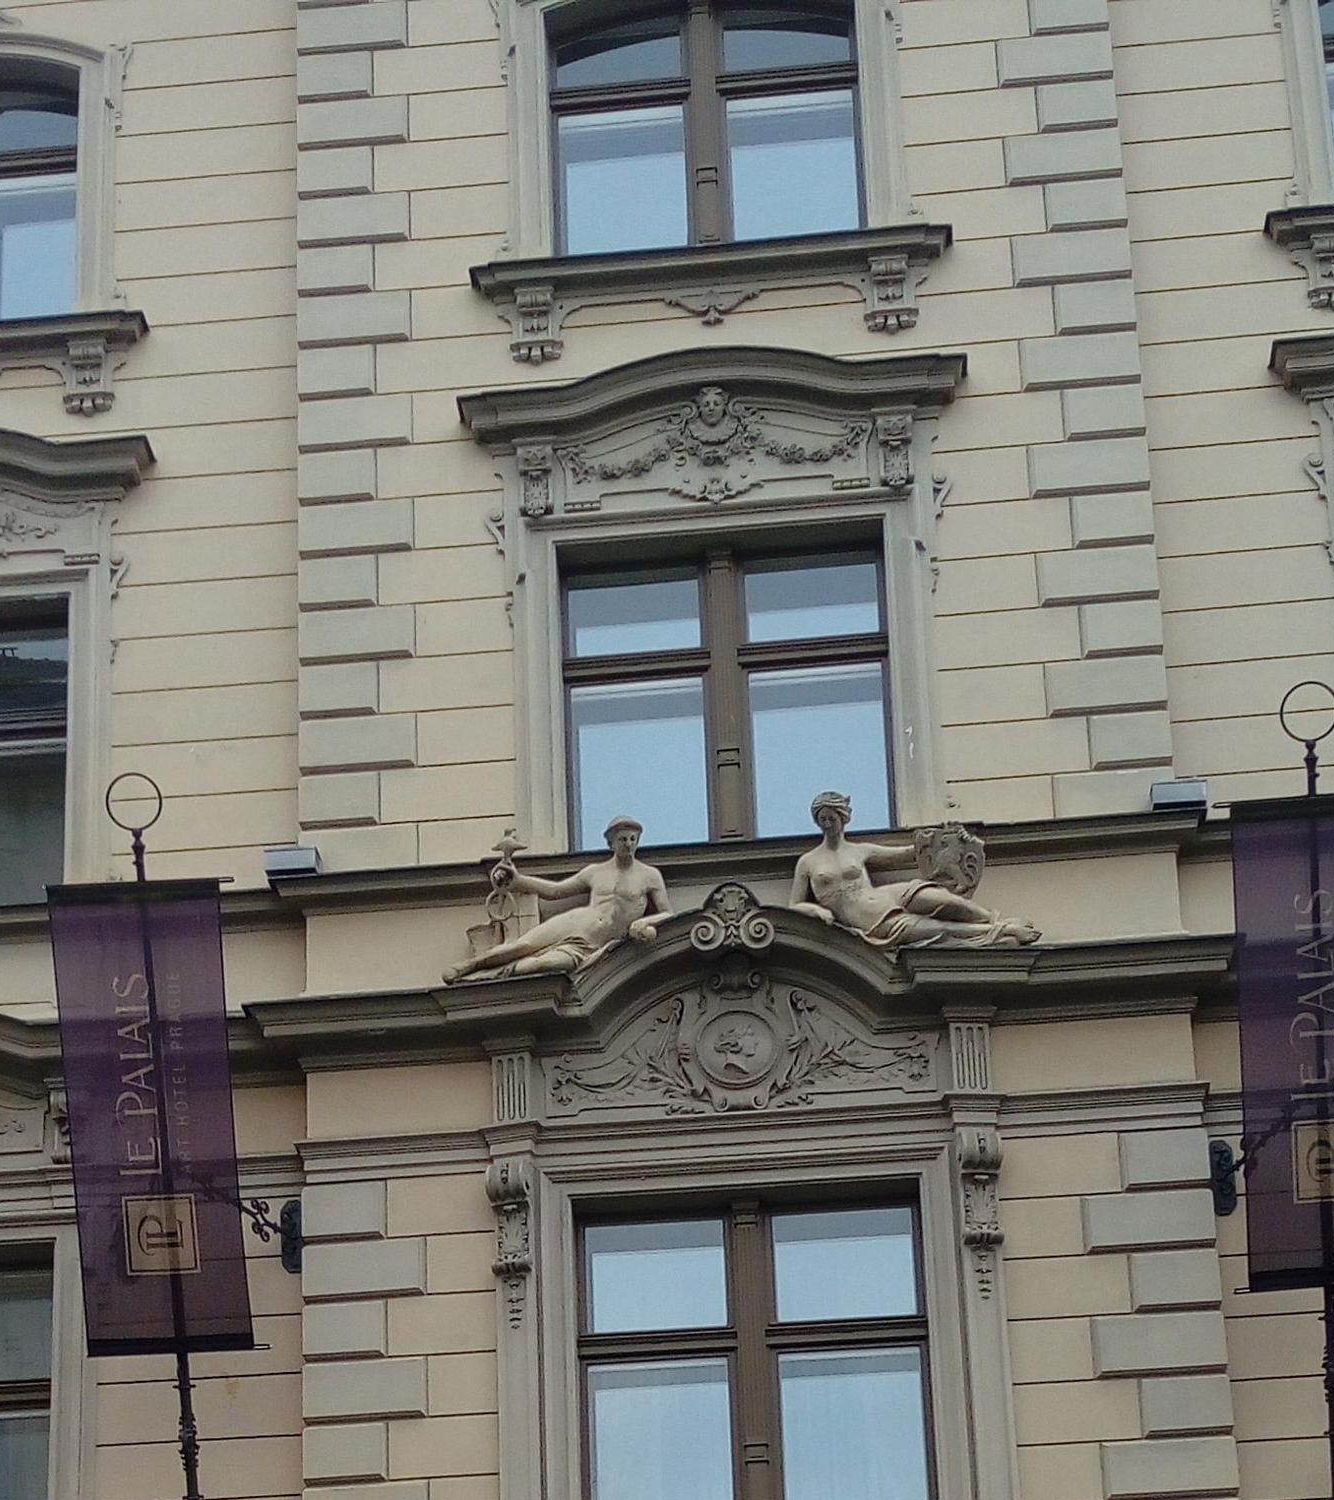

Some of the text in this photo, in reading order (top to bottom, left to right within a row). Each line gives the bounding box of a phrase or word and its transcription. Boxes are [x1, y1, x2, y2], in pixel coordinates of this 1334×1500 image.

[113, 973, 163, 1175] LE PALAIS
[171, 1062, 190, 1128] HOTEL
